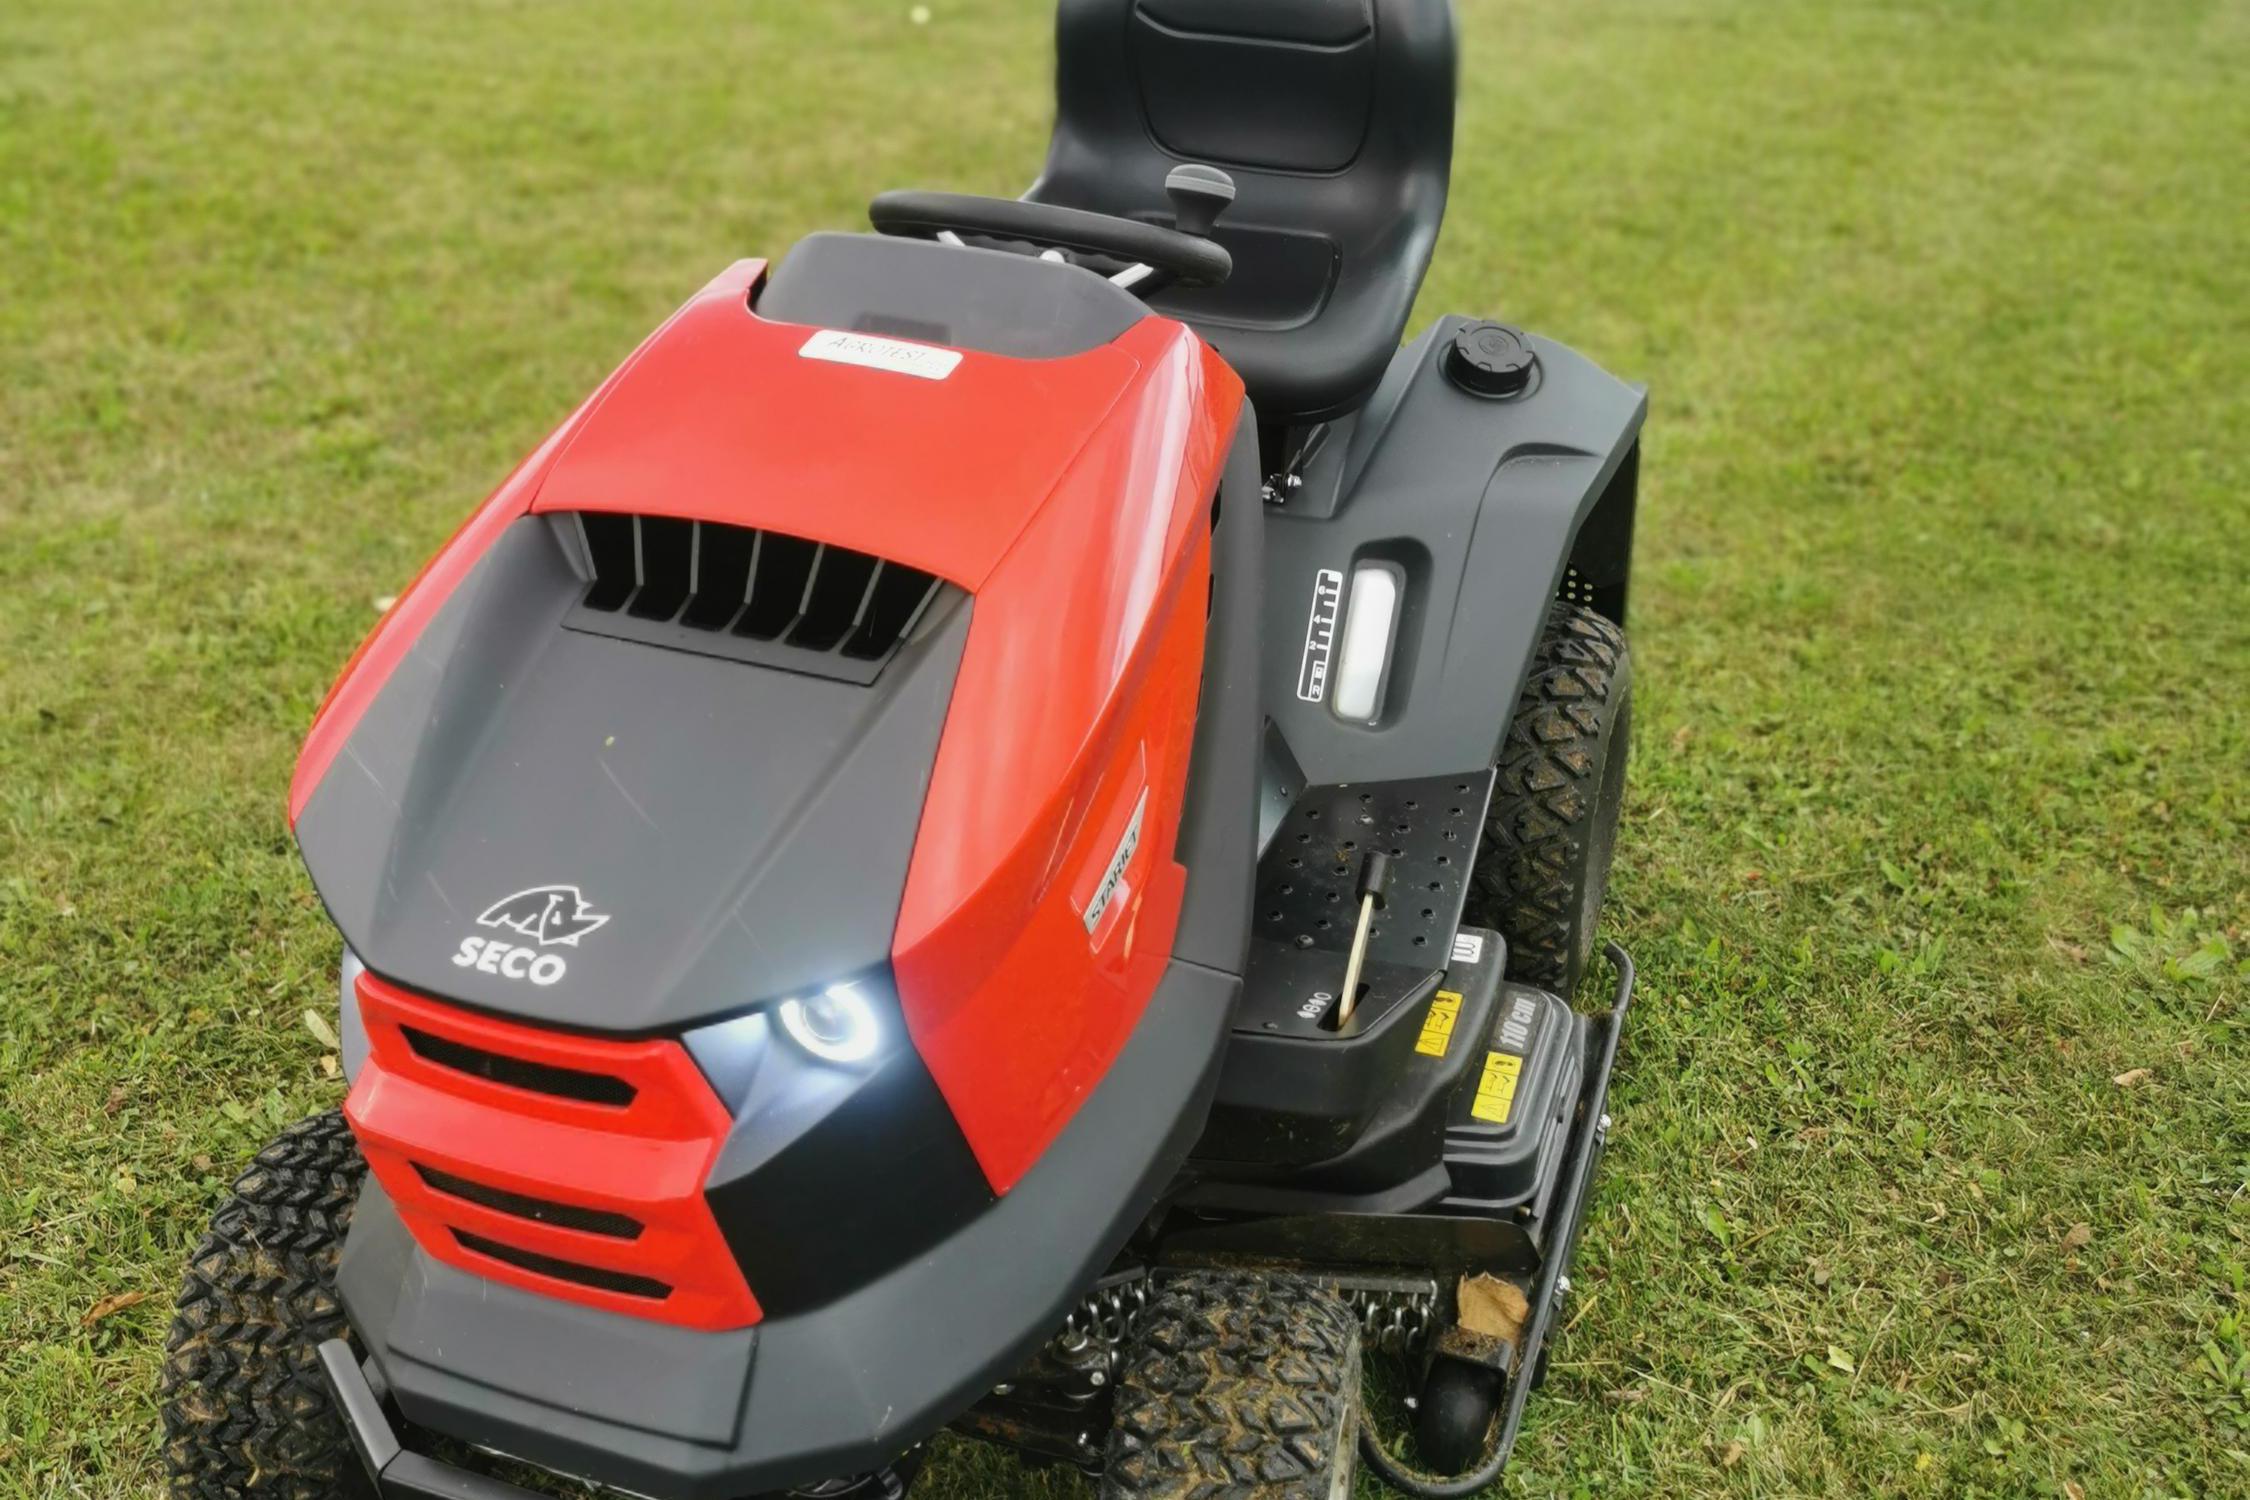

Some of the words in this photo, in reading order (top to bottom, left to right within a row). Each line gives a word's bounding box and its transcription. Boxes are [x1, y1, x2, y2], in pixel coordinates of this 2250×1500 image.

[1312, 615, 1321, 624] 4
[1308, 641, 1317, 650] 2
[1312, 684, 1321, 696] R
[451, 935, 566, 985] SECO
[1511, 997, 1537, 1025] cm
[1500, 1020, 1529, 1049] 110
